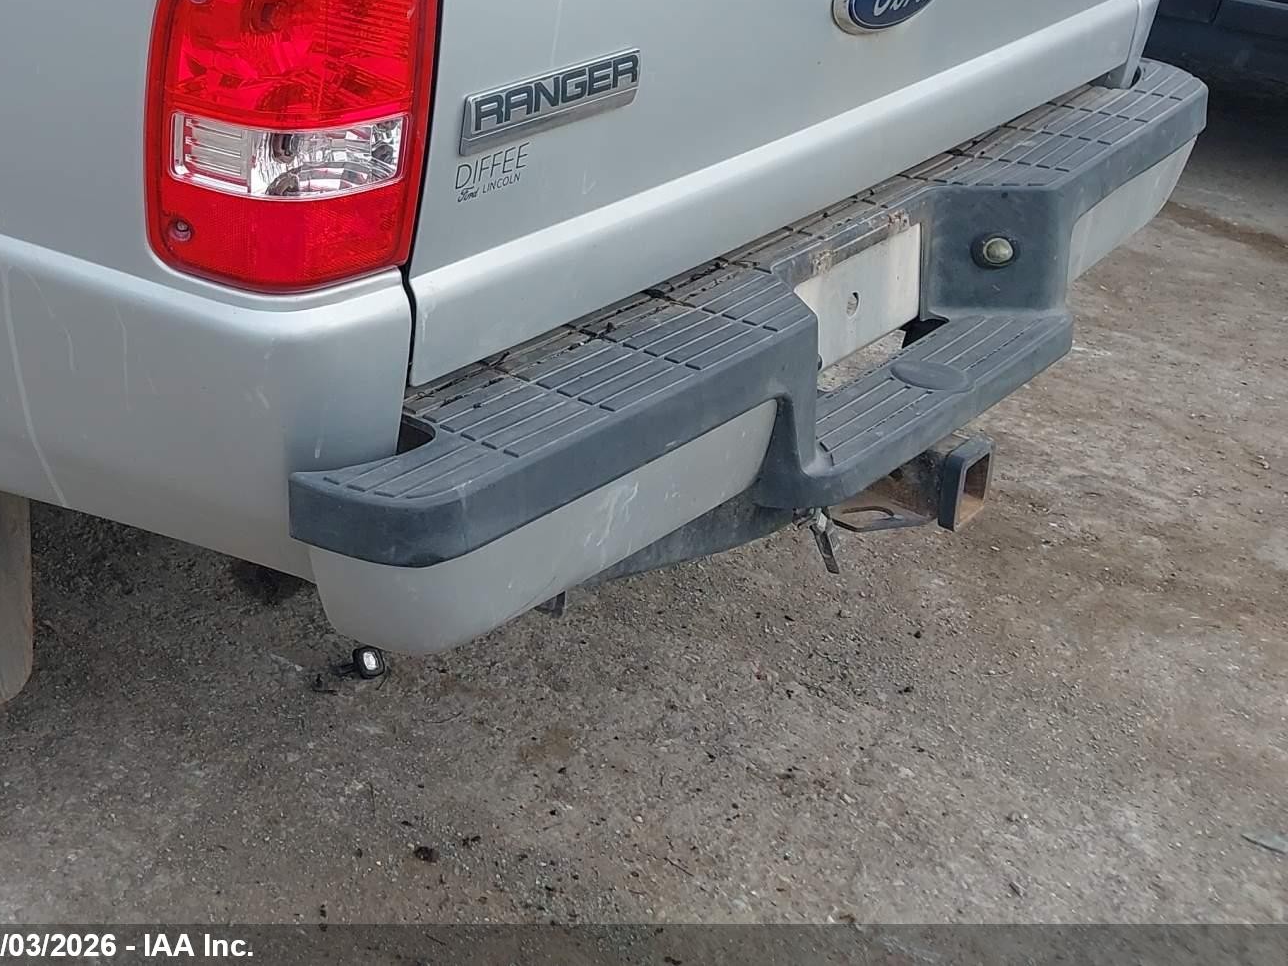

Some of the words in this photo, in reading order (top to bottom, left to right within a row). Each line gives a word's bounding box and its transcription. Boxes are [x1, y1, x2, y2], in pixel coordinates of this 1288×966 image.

[474, 54, 639, 132] RANGER
[455, 142, 530, 190] DIFFEE
[457, 186, 480, 203] Ford
[482, 172, 521, 194] LINCOLN
